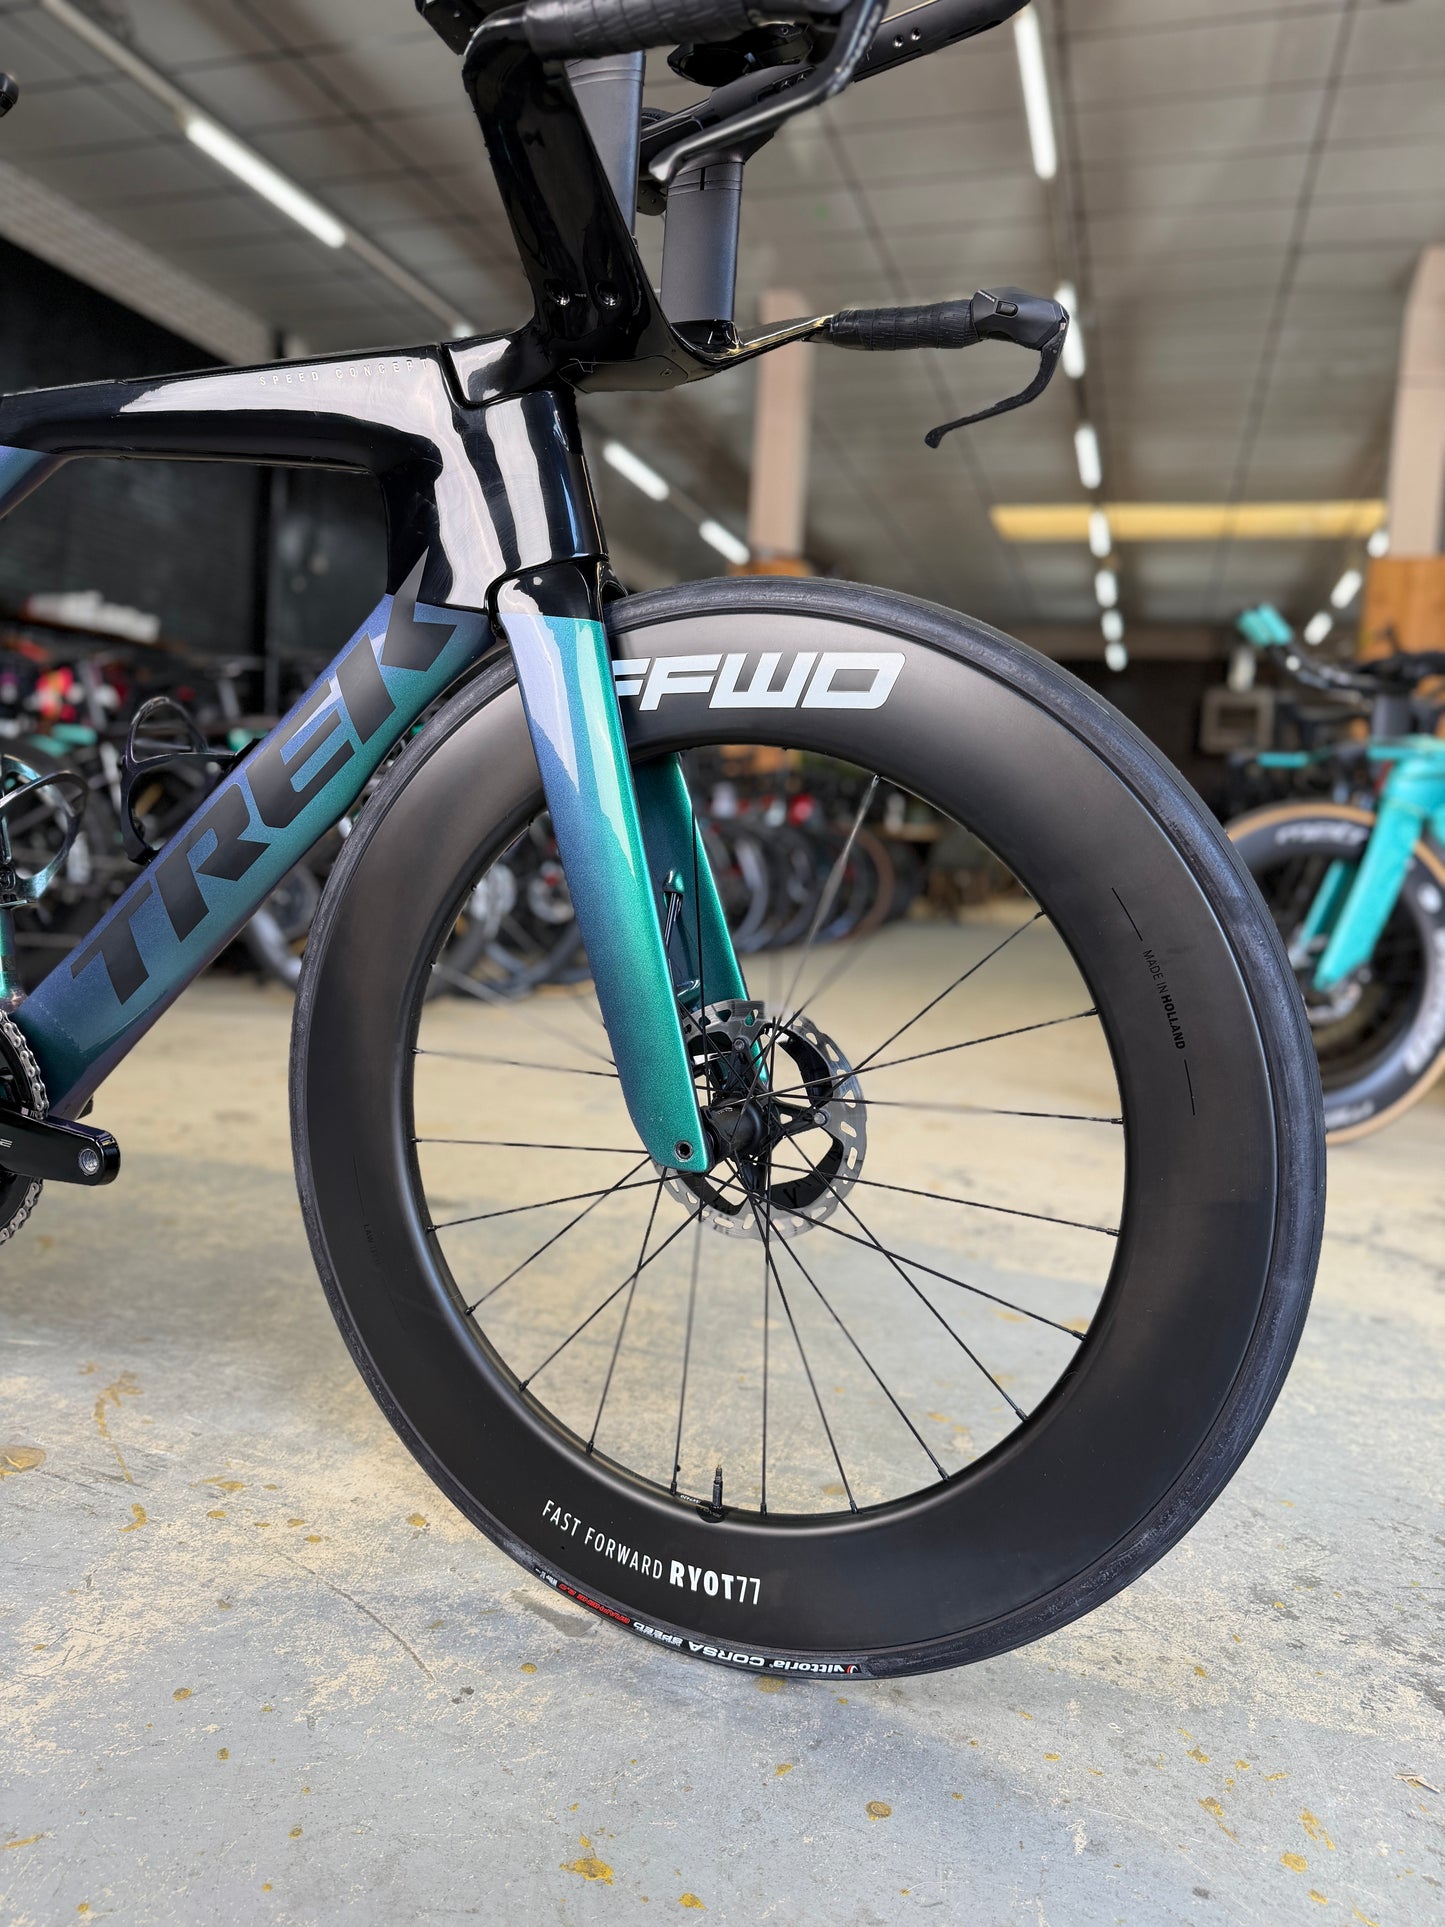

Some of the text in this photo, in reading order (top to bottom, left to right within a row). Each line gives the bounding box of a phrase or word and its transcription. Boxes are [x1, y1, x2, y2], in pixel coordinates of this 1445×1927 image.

[259, 358, 428, 386] SPEED CONCEPT
[72, 547, 458, 1005] TREK
[1142, 949, 1186, 1050] MADE IN HOLLAND
[541, 1499, 582, 1536] FAST
[584, 1528, 663, 1580] FORWARD
[670, 1560, 762, 1606] RYOT77
[688, 1641, 766, 1668] CORSA
